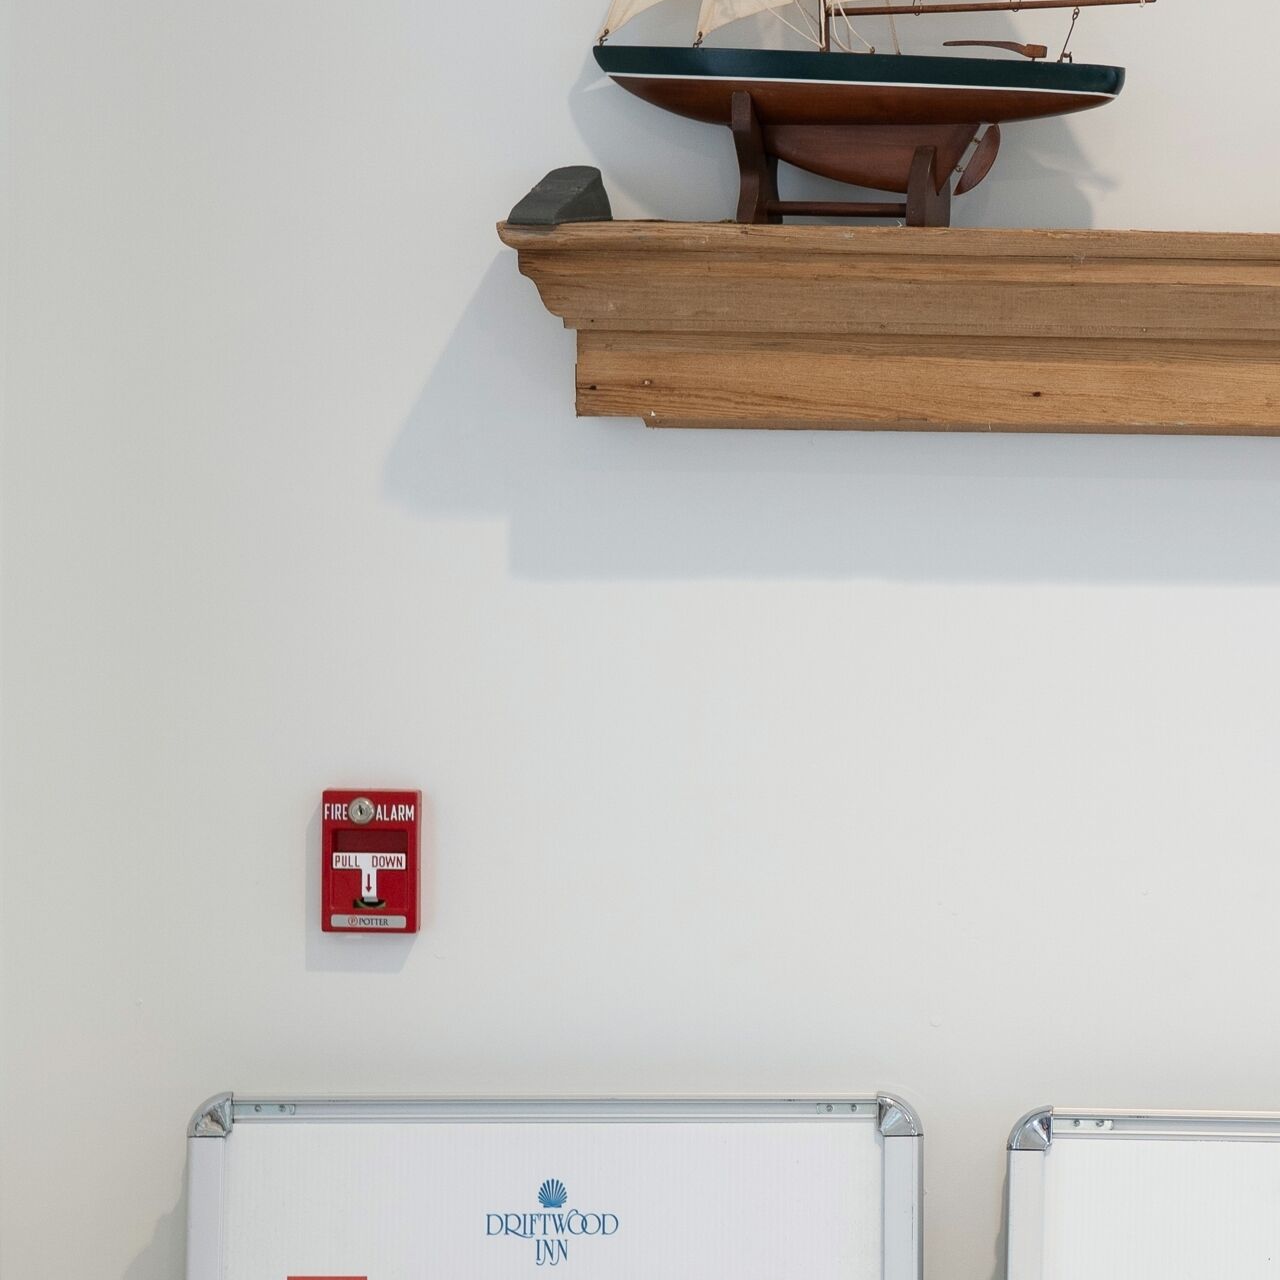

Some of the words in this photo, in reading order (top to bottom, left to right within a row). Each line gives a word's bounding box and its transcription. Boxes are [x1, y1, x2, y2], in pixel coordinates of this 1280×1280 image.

[324, 803, 348, 820] FIRE
[375, 804, 414, 821] ALARM
[334, 855, 360, 867] PULL
[371, 855, 403, 867] DOWN
[358, 917, 389, 926] POTTER
[487, 1209, 618, 1238] DRIFTWOOD
[536, 1240, 567, 1265] INN
